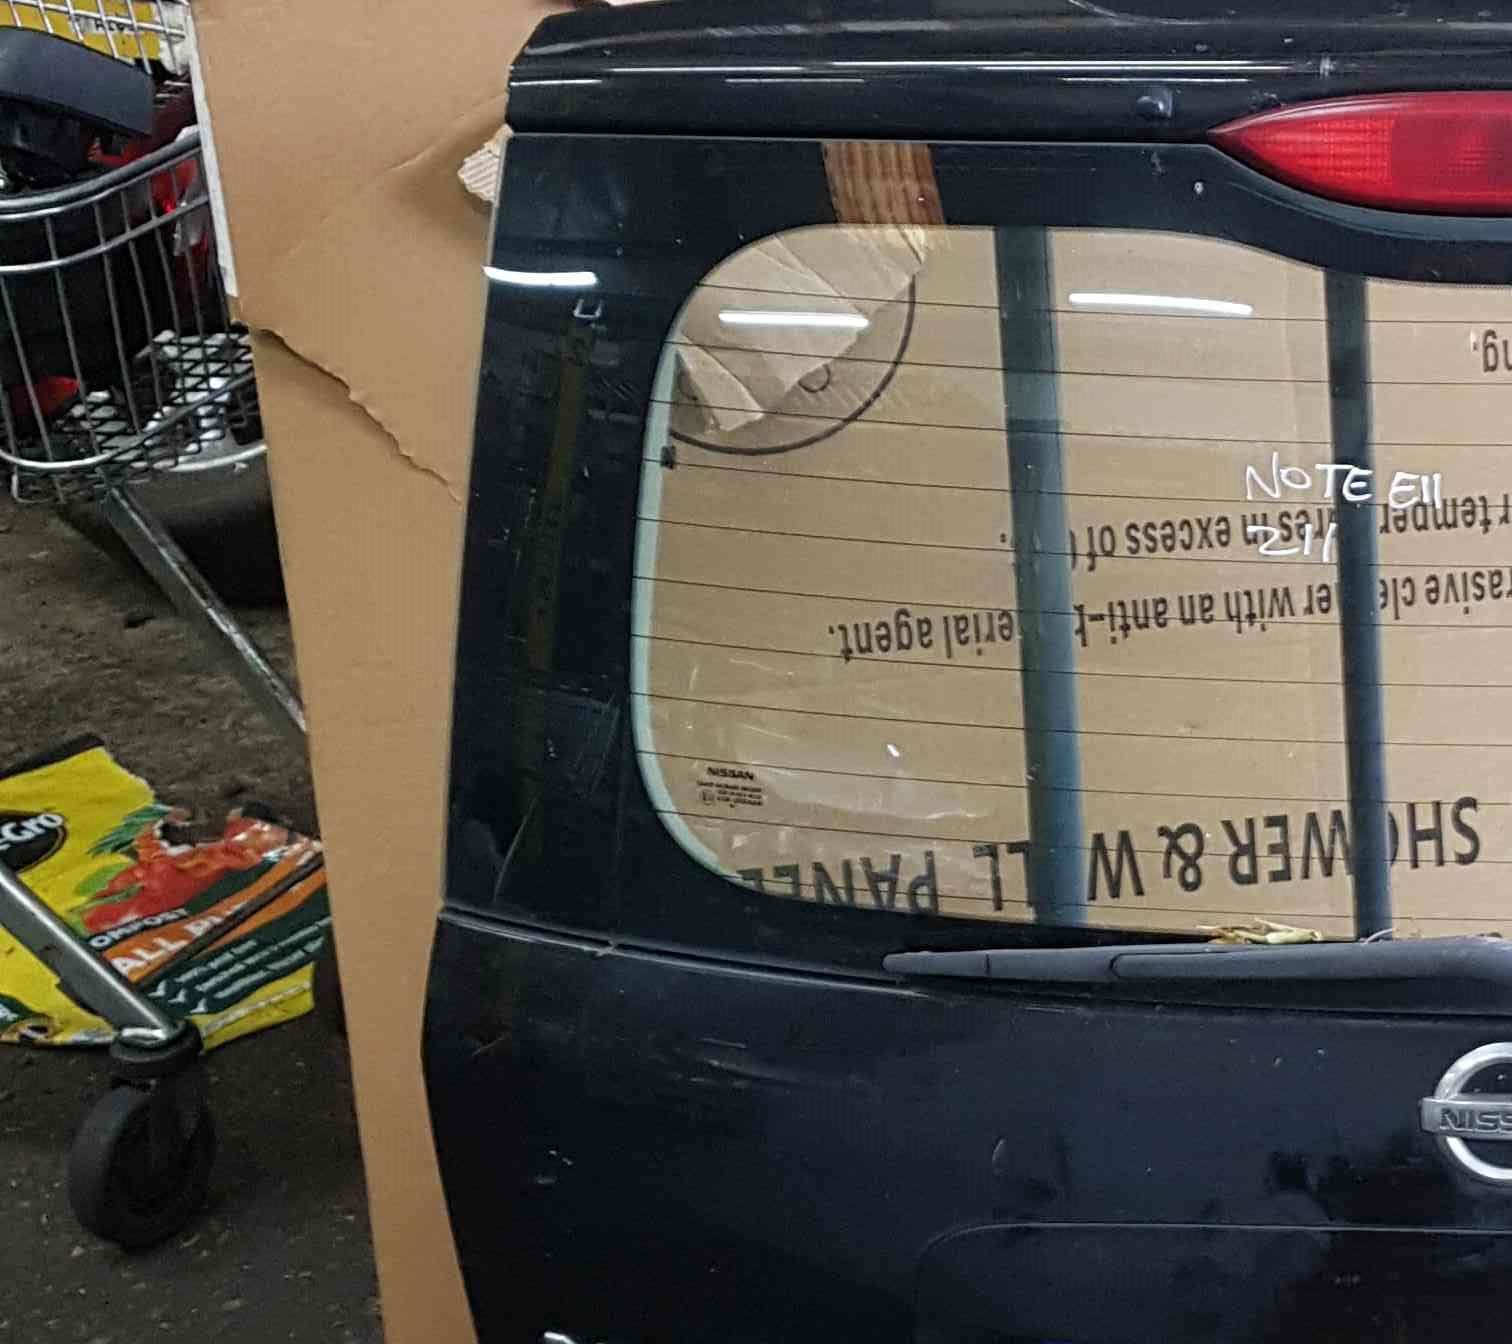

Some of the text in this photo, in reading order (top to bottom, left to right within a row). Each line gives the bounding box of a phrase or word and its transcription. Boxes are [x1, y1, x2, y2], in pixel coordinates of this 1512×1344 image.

[1246, 452, 1373, 501] NOTE
[1087, 518, 1117, 572] of
[1125, 515, 1232, 556] excess
[1180, 590, 1216, 623] an
[1224, 584, 1293, 633] with
[828, 606, 933, 664] agent.
[971, 829, 1145, 912] WLL
[1157, 822, 1205, 892] &
